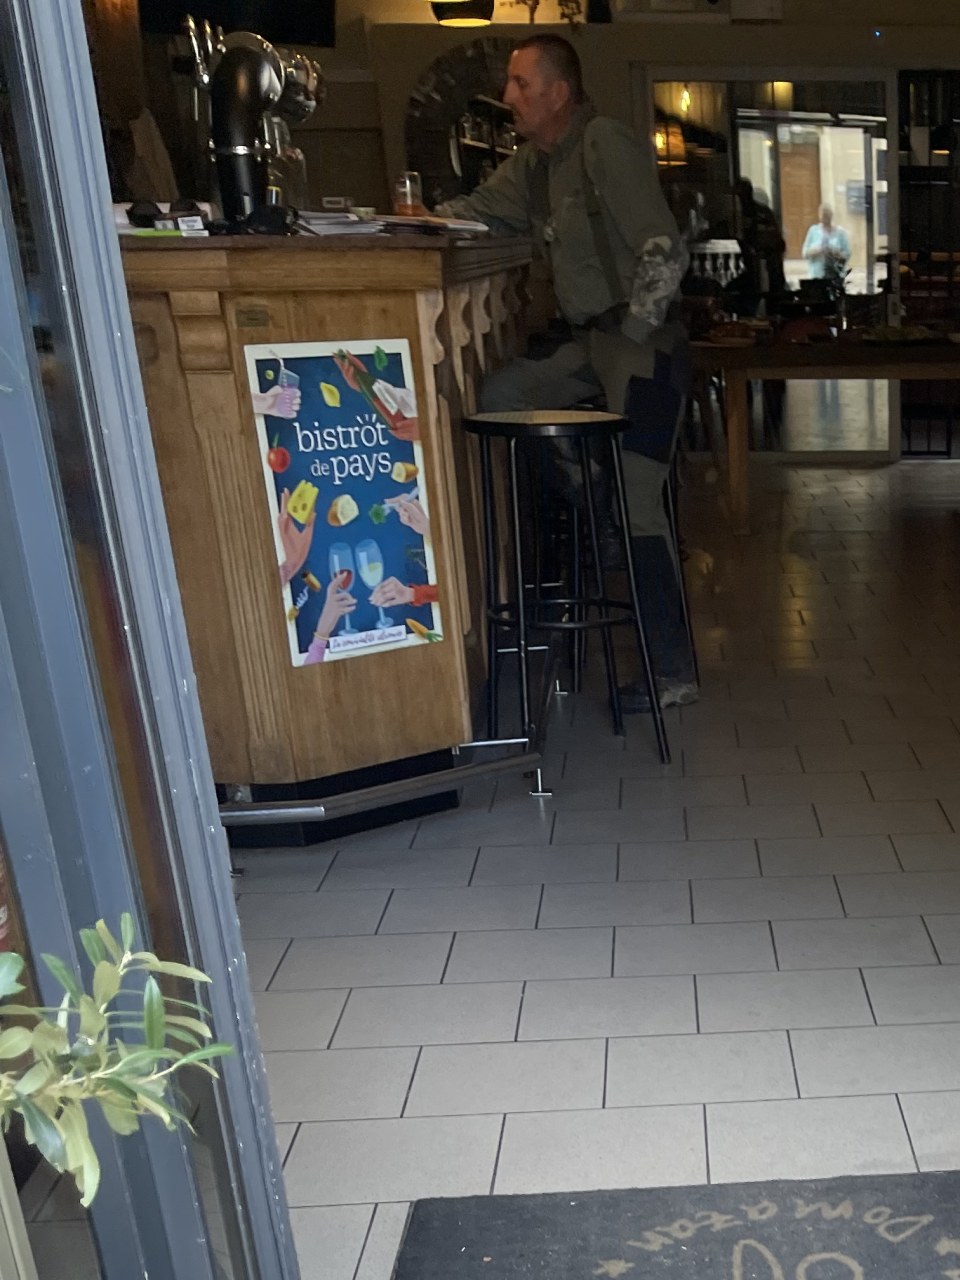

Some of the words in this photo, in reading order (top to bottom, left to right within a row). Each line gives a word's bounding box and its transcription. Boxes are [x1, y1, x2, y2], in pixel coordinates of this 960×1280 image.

[310, 459, 330, 477] de
[330, 452, 392, 485] pays
[626, 1197, 935, 1252] Domazan
